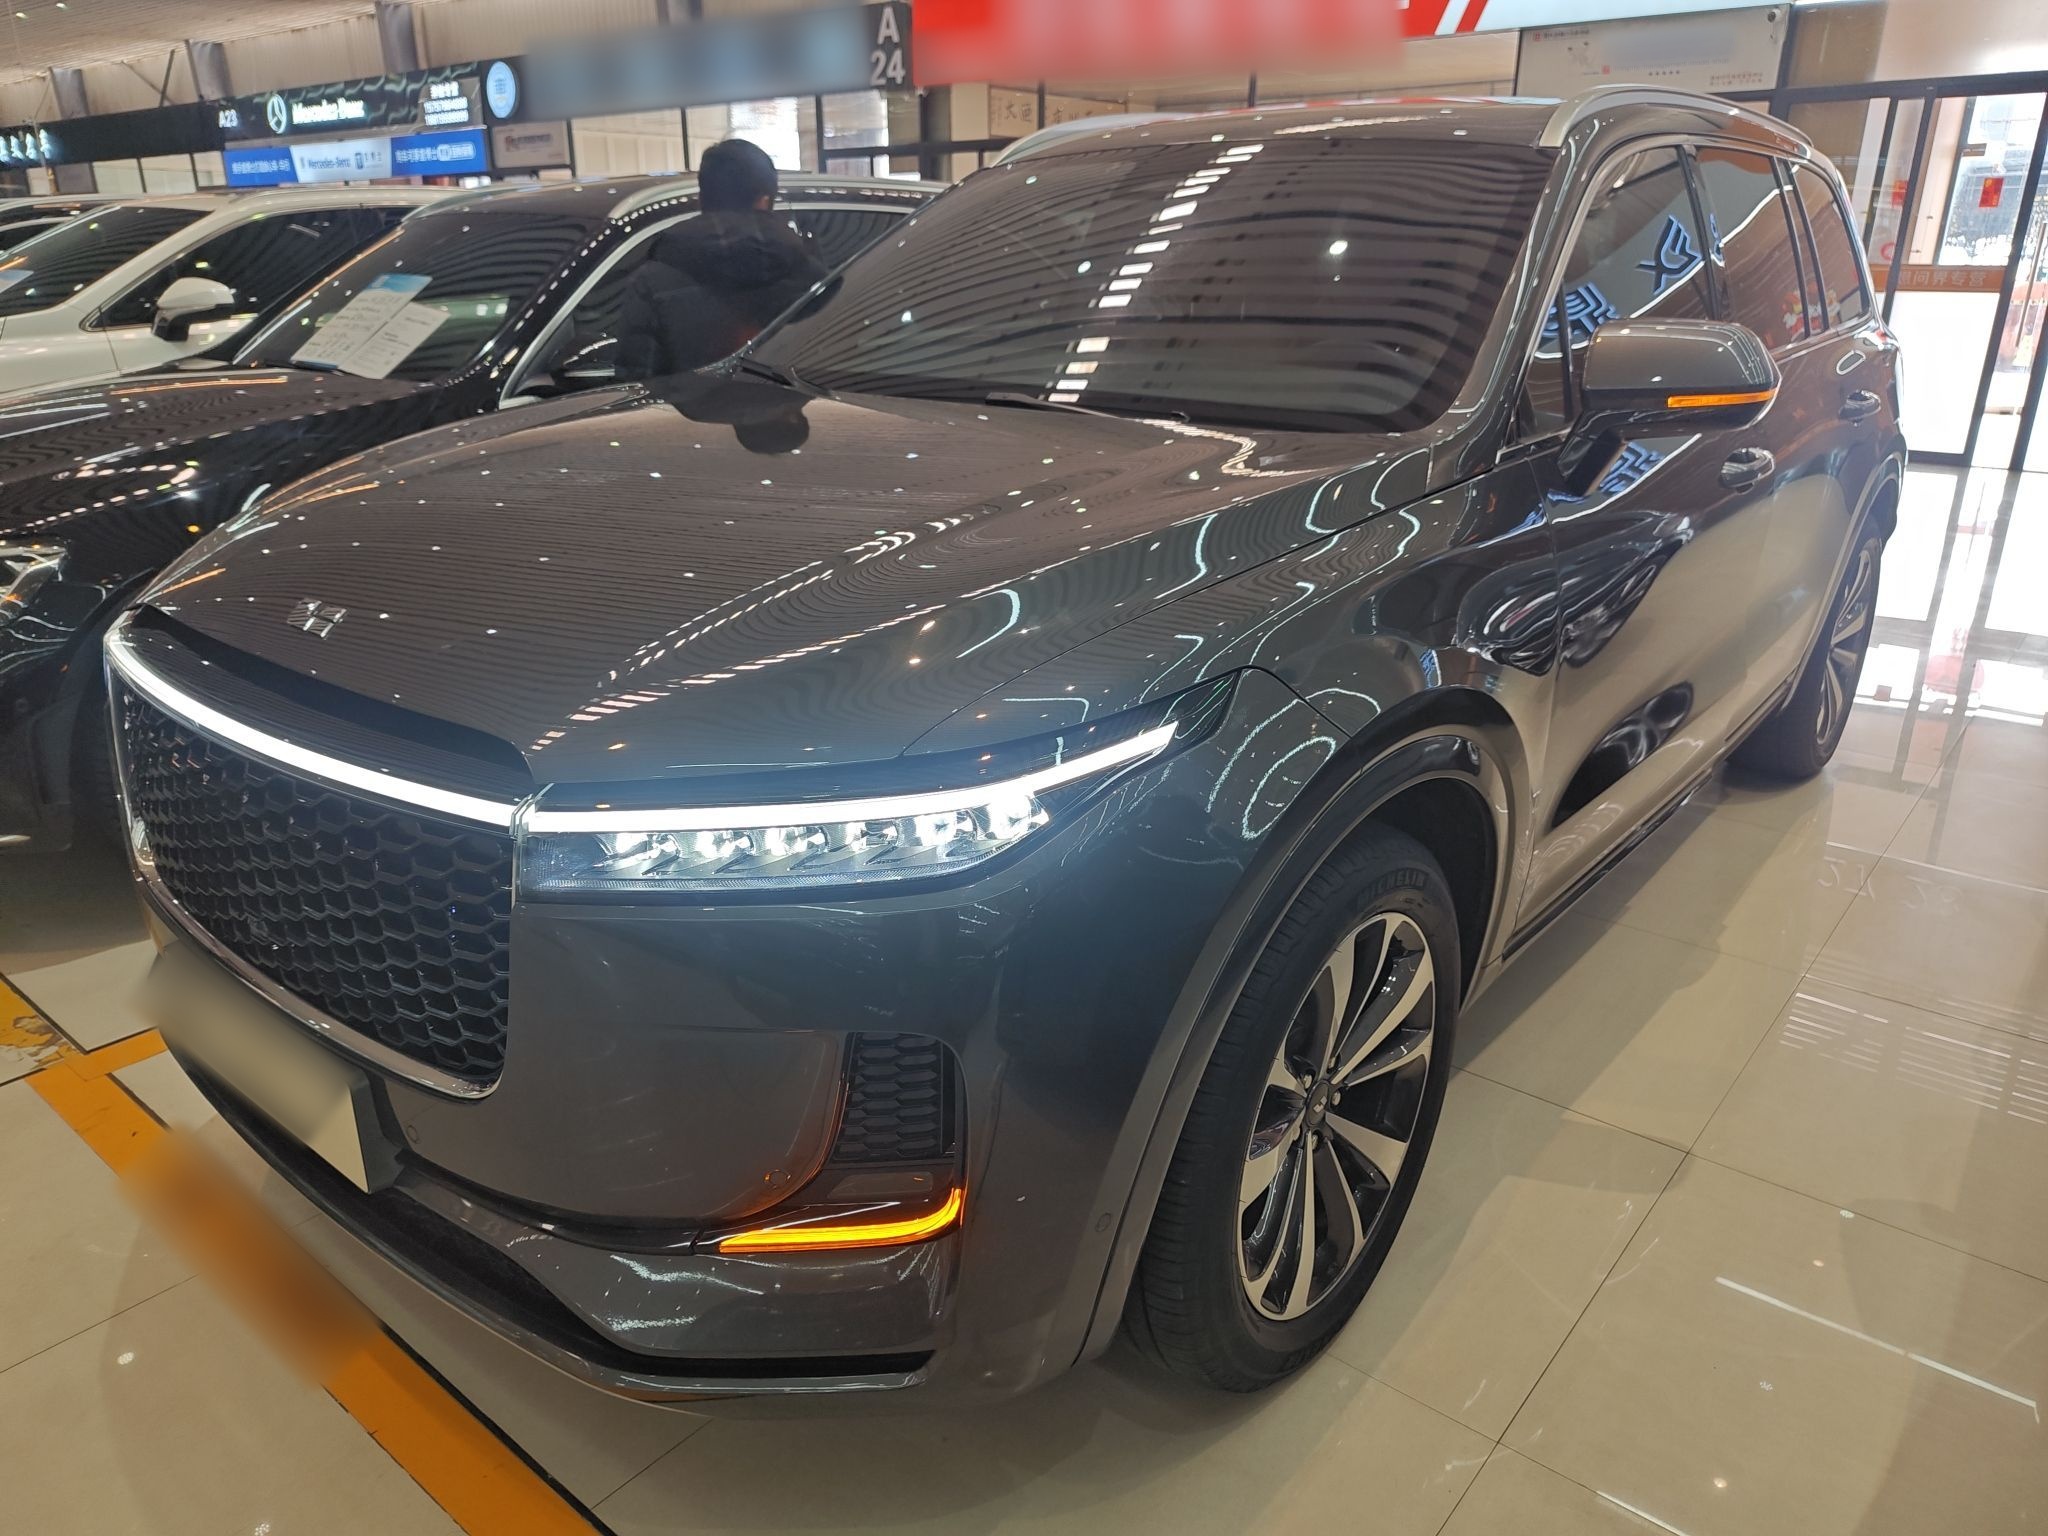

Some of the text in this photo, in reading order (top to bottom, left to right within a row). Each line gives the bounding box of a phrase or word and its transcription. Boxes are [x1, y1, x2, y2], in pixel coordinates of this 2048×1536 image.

[877, 6, 900, 45] A
[871, 48, 906, 86] 24
[218, 109, 239, 128] A23
